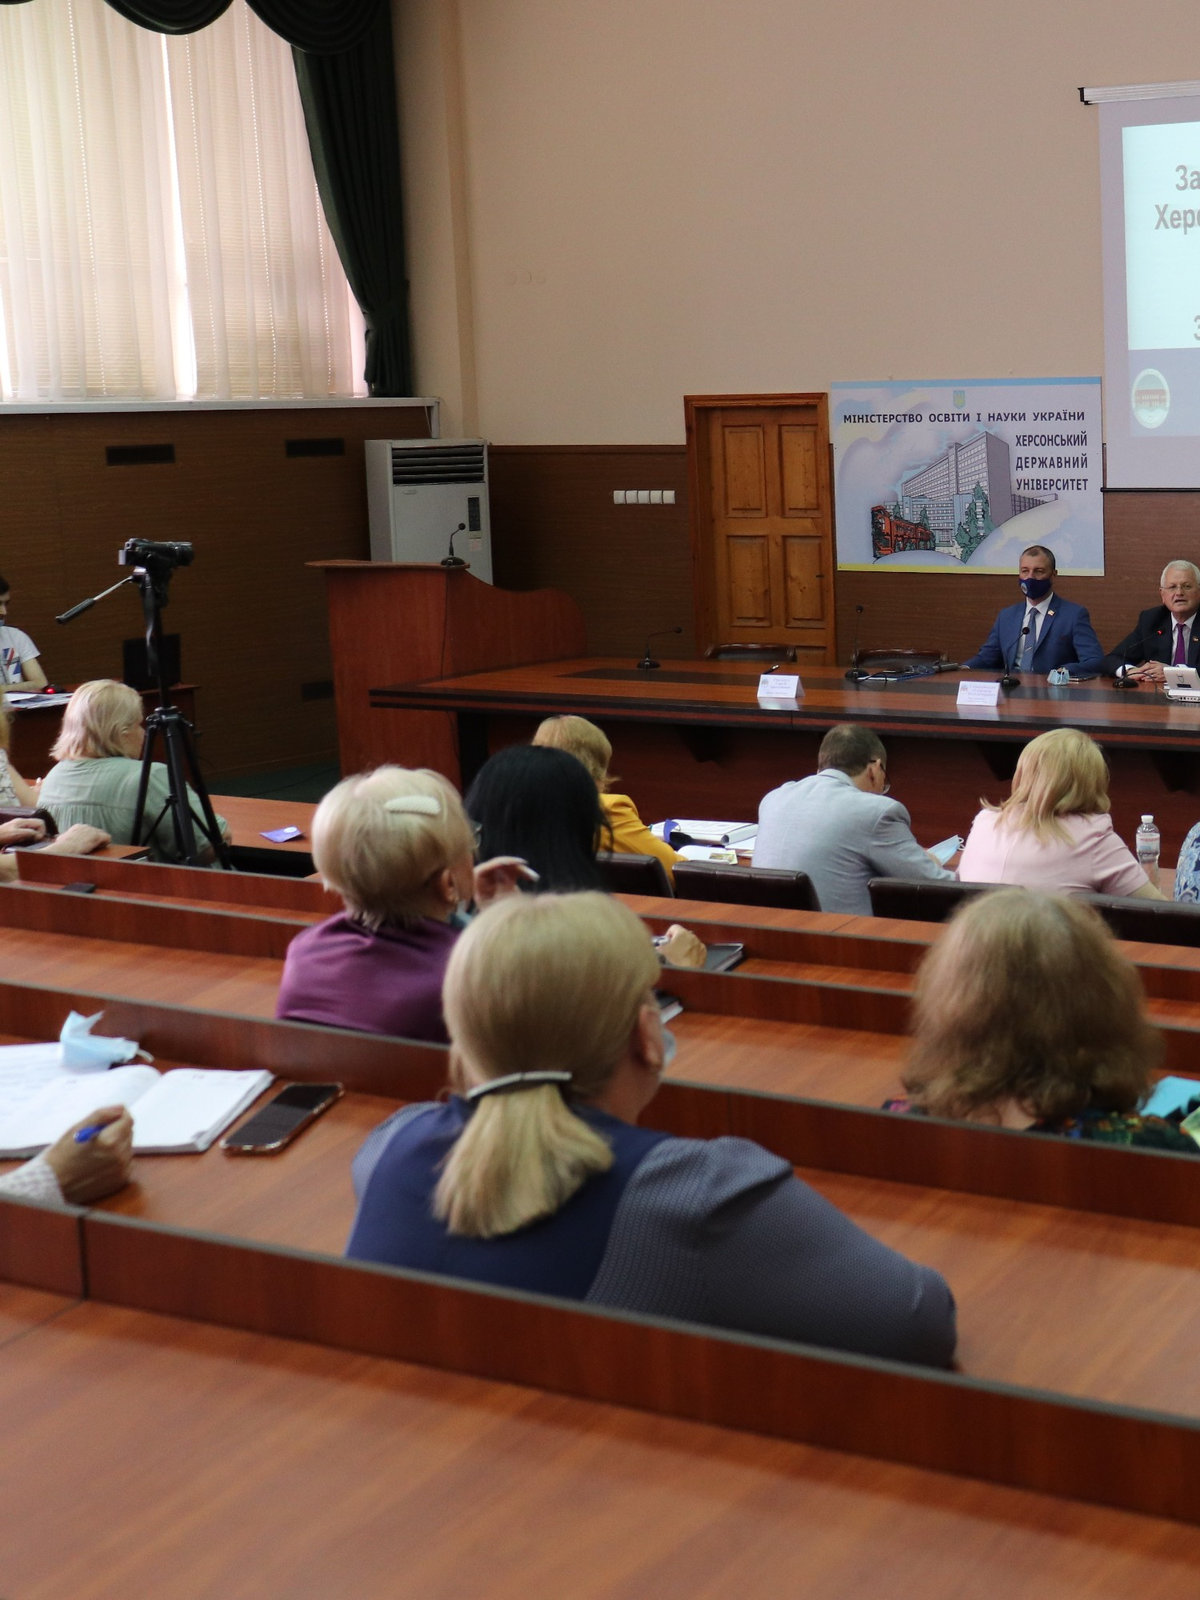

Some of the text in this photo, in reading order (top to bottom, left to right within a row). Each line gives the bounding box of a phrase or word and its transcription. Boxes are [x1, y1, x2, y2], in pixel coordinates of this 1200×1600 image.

[843, 414, 923, 423] МІНІСТЕРСТВО
[929, 413, 970, 422] ОСВІТИ
[988, 412, 1026, 422] НАУКИ
[1033, 409, 1085, 421] УКРАЇНИ
[1015, 431, 1087, 447] ХЕРСОНСЬКИЙ
[1016, 453, 1088, 471] ДЕРЖАВНИЙ
[1016, 479, 1088, 491] УНІВЕРСИТЕТ
